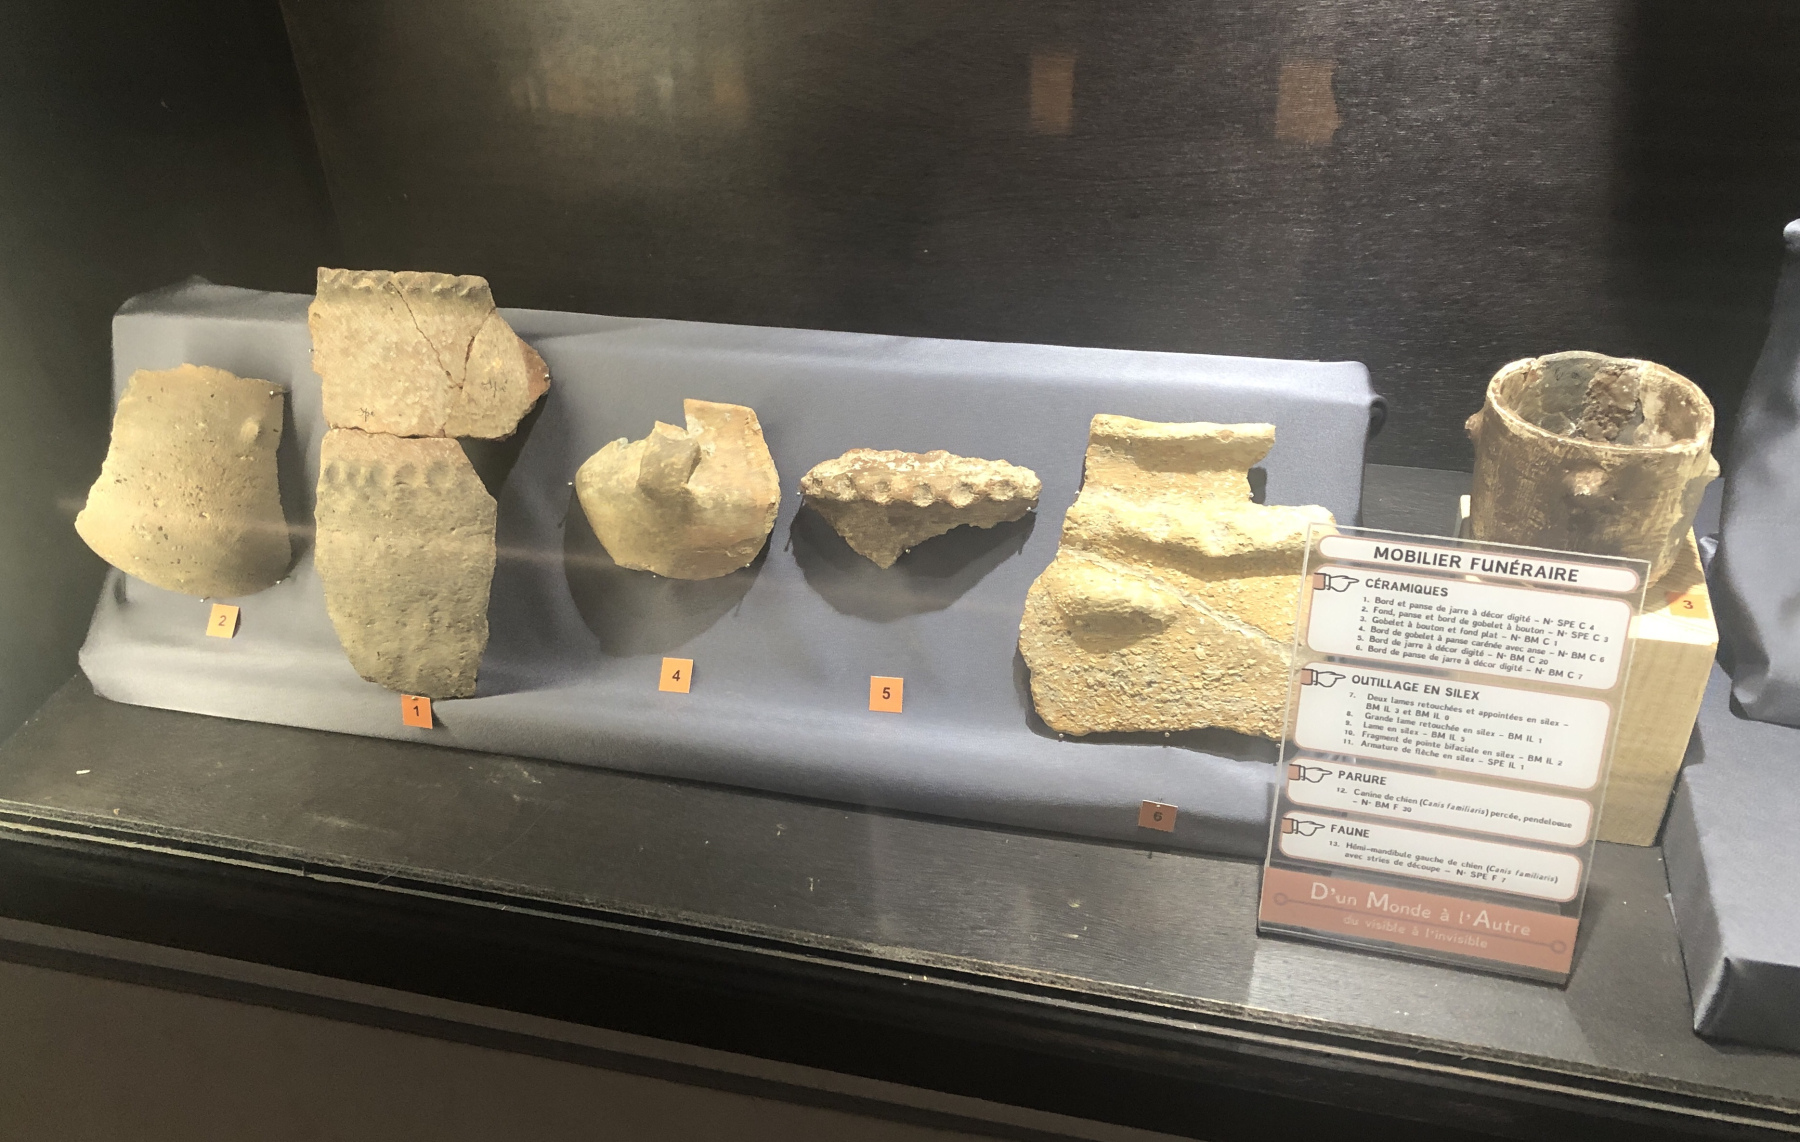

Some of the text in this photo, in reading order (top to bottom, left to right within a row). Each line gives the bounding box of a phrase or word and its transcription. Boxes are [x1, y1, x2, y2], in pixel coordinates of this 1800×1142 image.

[1373, 546, 1579, 583] MOBILIER FUNÉRAIRE
[1365, 577, 1449, 598] CÉRAMIQUES
[1374, 596, 1395, 606] Bord
[1396, 600, 1406, 608] et
[1408, 602, 1433, 611] panse
[1435, 604, 1446, 613] de
[1448, 605, 1469, 616] jarre
[1480, 610, 1504, 619] décor
[1506, 613, 1531, 624] digité
[1556, 618, 1576, 629] SPE
[1683, 600, 1693, 609] 3
[218, 615, 227, 626] 2
[1361, 605, 1590, 641] 2. Fond, panse et bord de gobelet bouton SPE
[1371, 615, 1404, 627] Gobelet
[1415, 621, 1445, 632] bouton
[1447, 626, 1457, 634] et
[1459, 626, 1479, 637] fond
[1480, 630, 1498, 639] plat
[1523, 635, 1540, 644] BM
[1356, 634, 1364, 642] 5.
[1368, 634, 1389, 645] Bord
[1391, 638, 1402, 647] de
[1403, 639, 1424, 649] jarre
[1435, 644, 1458, 653] décor
[1460, 647, 1485, 658] digité
[1509, 653, 1525, 663] BM
[1538, 658, 1549, 666] 20
[1370, 625, 1390, 635] Bord
[1391, 628, 1402, 637] de
[1404, 631, 1434, 641] gobelet
[1444, 637, 1469, 645] panse
[1471, 640, 1503, 650] carénée
[1504, 644, 1524, 653] avec
[1526, 647, 1546, 655] anse
[1570, 651, 1587, 660] BM
[1367, 644, 1388, 655] Bord
[1389, 648, 1400, 656] de
[1402, 651, 1427, 660] panse
[1428, 653, 1439, 661] de
[1441, 654, 1462, 664] jarre
[1473, 659, 1496, 668] décor
[1499, 662, 1523, 673] digité
[1548, 668, 1564, 678] BM
[672, 670, 681, 682] 4
[1351, 674, 1480, 701] OUTILLAGE EN SILEX
[882, 687, 891, 700] 5
[413, 705, 419, 717] 1
[1349, 691, 1356, 699] 7.
[1366, 693, 1388, 703] Deux
[1390, 696, 1415, 707] lames
[1417, 701, 1463, 714] retouchées
[1478, 710, 1523, 722] appointées
[1540, 718, 1559, 727] silex
[1365, 702, 1381, 712] BM
[1383, 705, 1391, 713] IL
[1415, 709, 1430, 718] BM
[1432, 712, 1441, 720] IL
[1362, 721, 1384, 731] Lame
[1400, 727, 1419, 736] silex
[1430, 730, 1446, 740] BM
[1448, 733, 1456, 741] IL
[1364, 711, 1394, 723] Grande
[1396, 716, 1416, 726] lame
[1419, 721, 1460, 732] retouchée
[1476, 728, 1495, 737] silex
[1507, 732, 1523, 741] BM
[1525, 734, 1534, 743] IL
[1360, 739, 1399, 752] Armature
[1401, 746, 1412, 754] de
[1414, 747, 1440, 758] flèche
[1455, 754, 1475, 763] silex
[1487, 758, 1505, 768] SPE
[1508, 761, 1516, 769] IL
[1361, 730, 1399, 743] Fragment
[1402, 736, 1413, 745] de
[1415, 740, 1441, 749] pointe
[1444, 742, 1479, 754] bifaciale
[1495, 750, 1515, 759] silex
[1527, 754, 1543, 763] BM
[1545, 757, 1553, 765] IL
[1337, 770, 1387, 786] PARURE
[1153, 811, 1163, 822] 6
[1353, 788, 1382, 799] Canine
[1383, 793, 1395, 801] de
[1395, 795, 1418, 805] chien
[1489, 811, 1522, 822] percée,
[1374, 800, 1390, 810] BM
[1330, 823, 1370, 839] FAUNE
[1344, 852, 1362, 860] avec
[1366, 855, 1390, 865] stries
[1393, 859, 1404, 867] de
[1406, 861, 1441, 873] découpe
[1470, 870, 1487, 880] SPE
[1414, 854, 1444, 864] gauche
[1460, 861, 1483, 870] chien
[1366, 890, 1431, 919] Monde
[1343, 915, 1359, 926] du
[1365, 919, 1406, 934] visible
